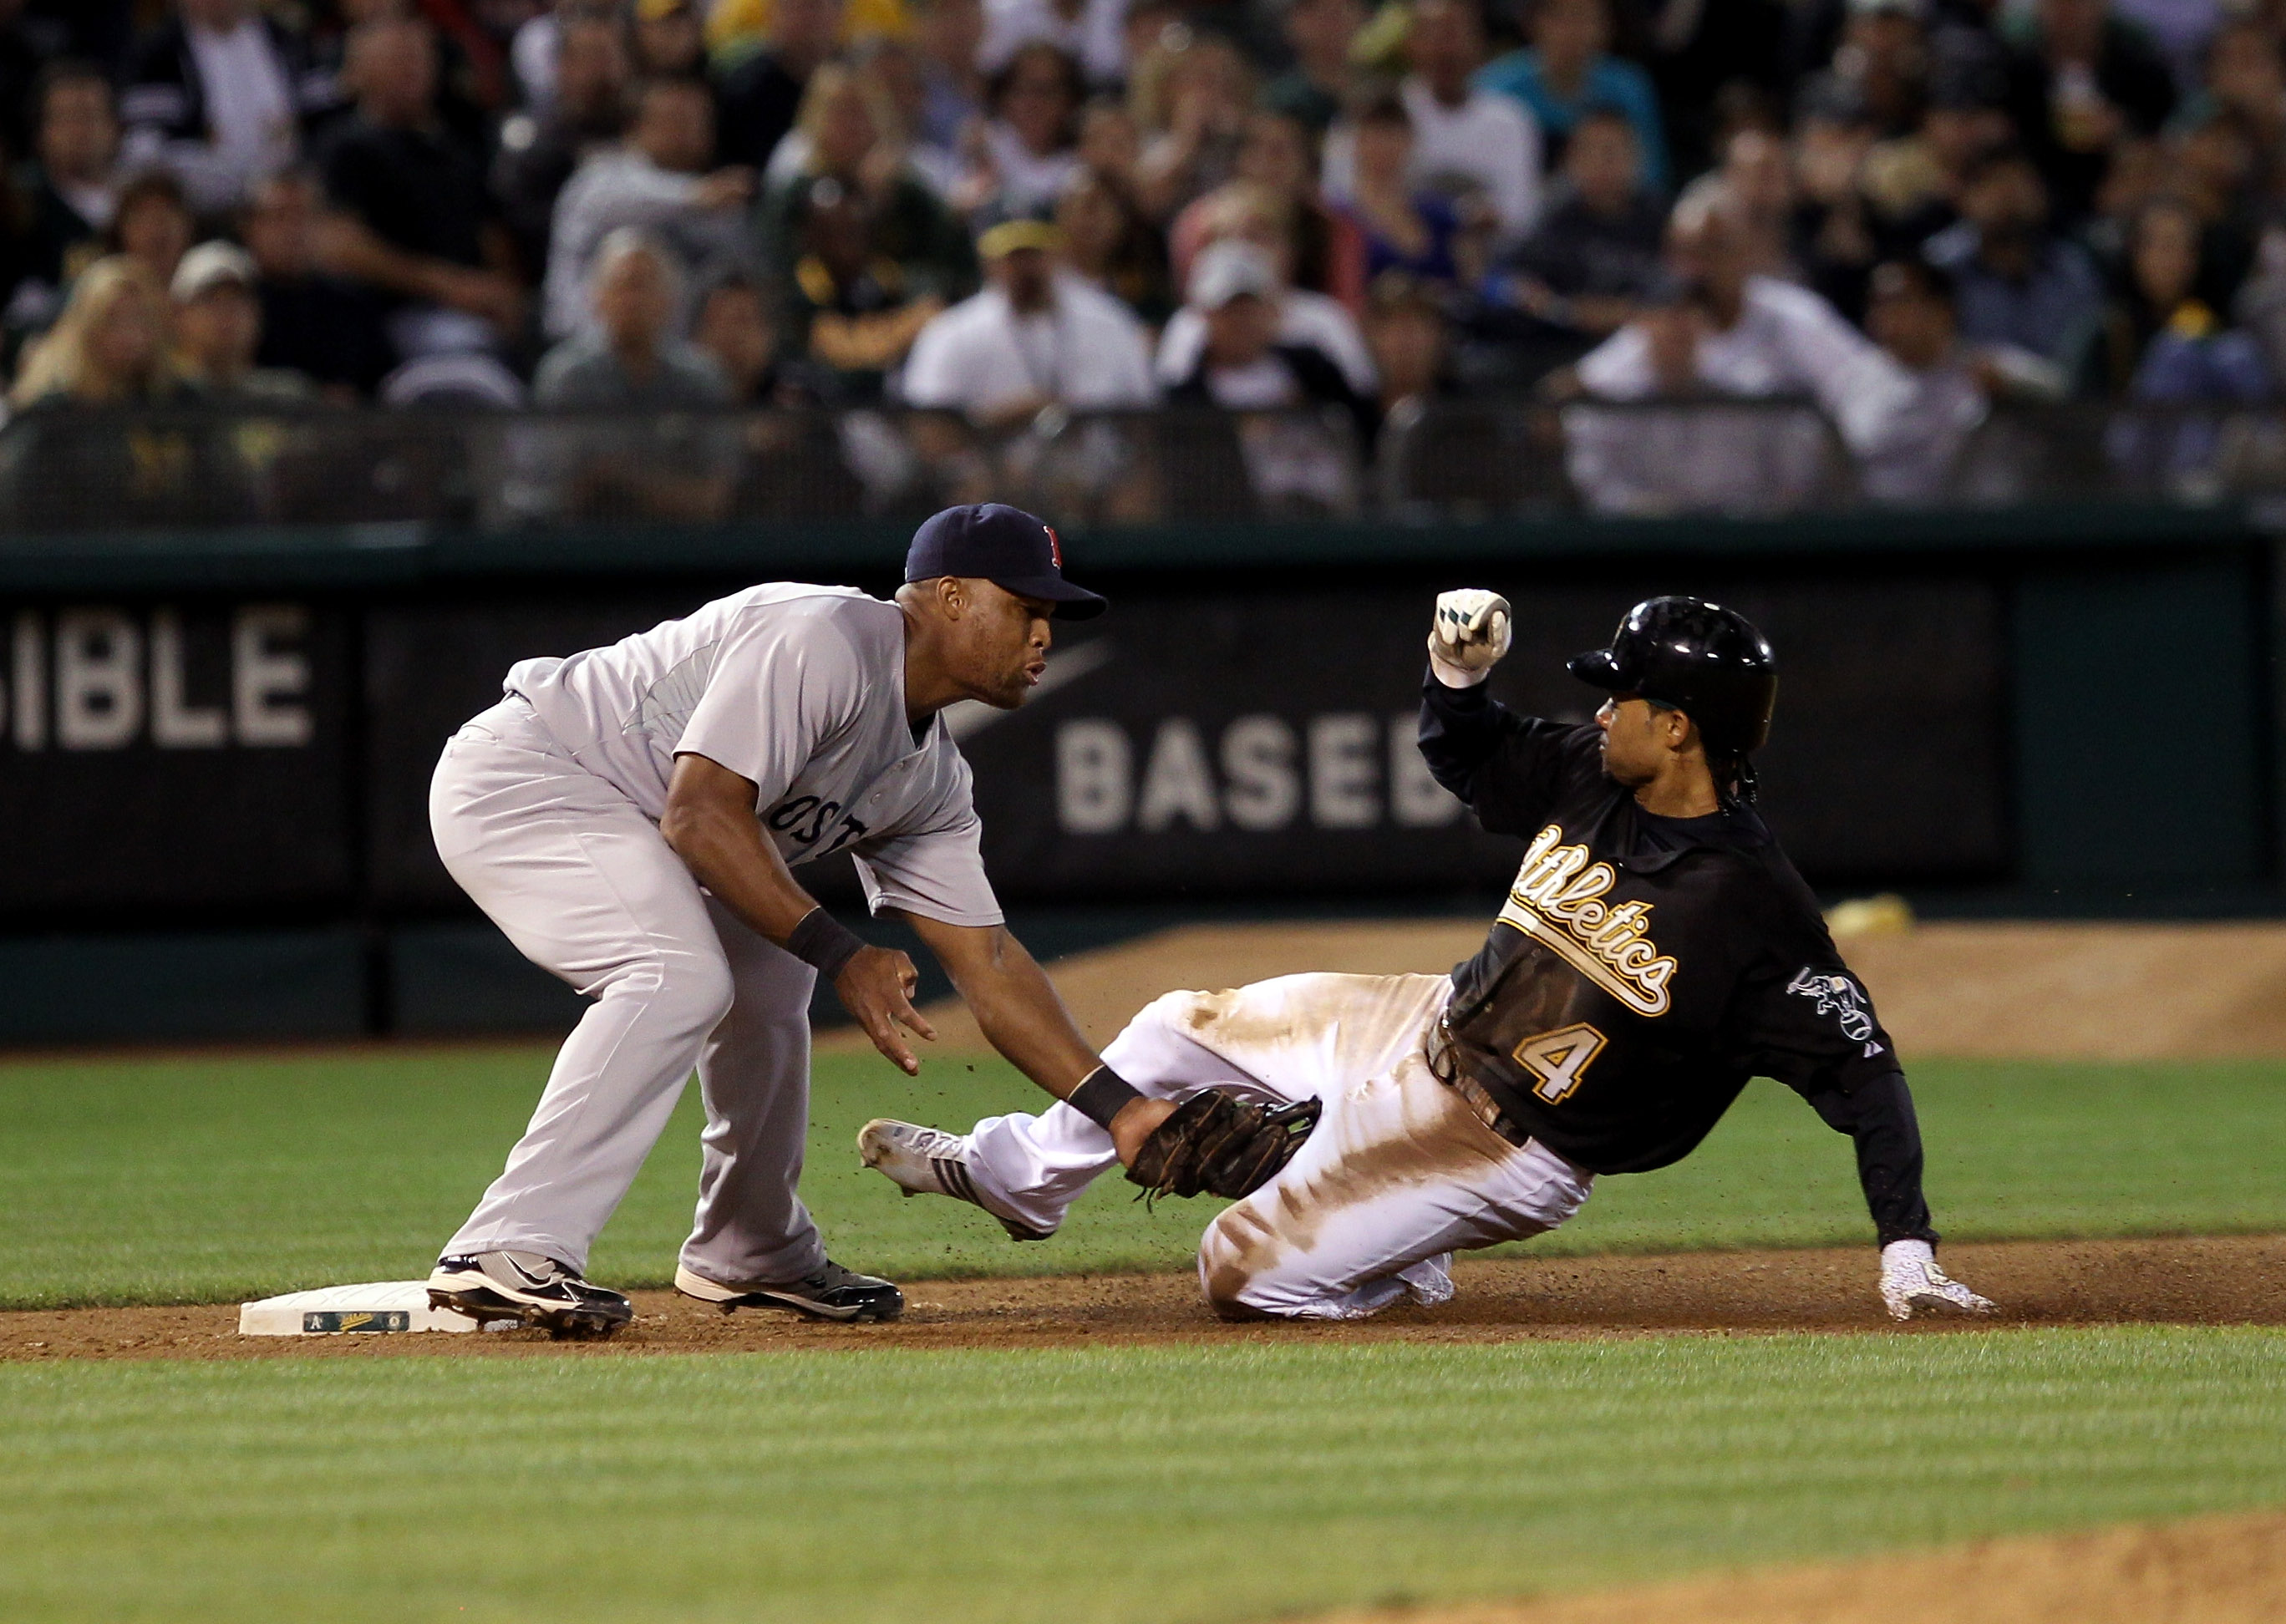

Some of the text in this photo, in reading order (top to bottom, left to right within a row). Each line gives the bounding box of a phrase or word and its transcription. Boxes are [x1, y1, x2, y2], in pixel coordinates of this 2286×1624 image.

[0, 604, 315, 750] IBLE
[770, 789, 869, 858] OST
[1512, 1021, 1608, 1107] 4
